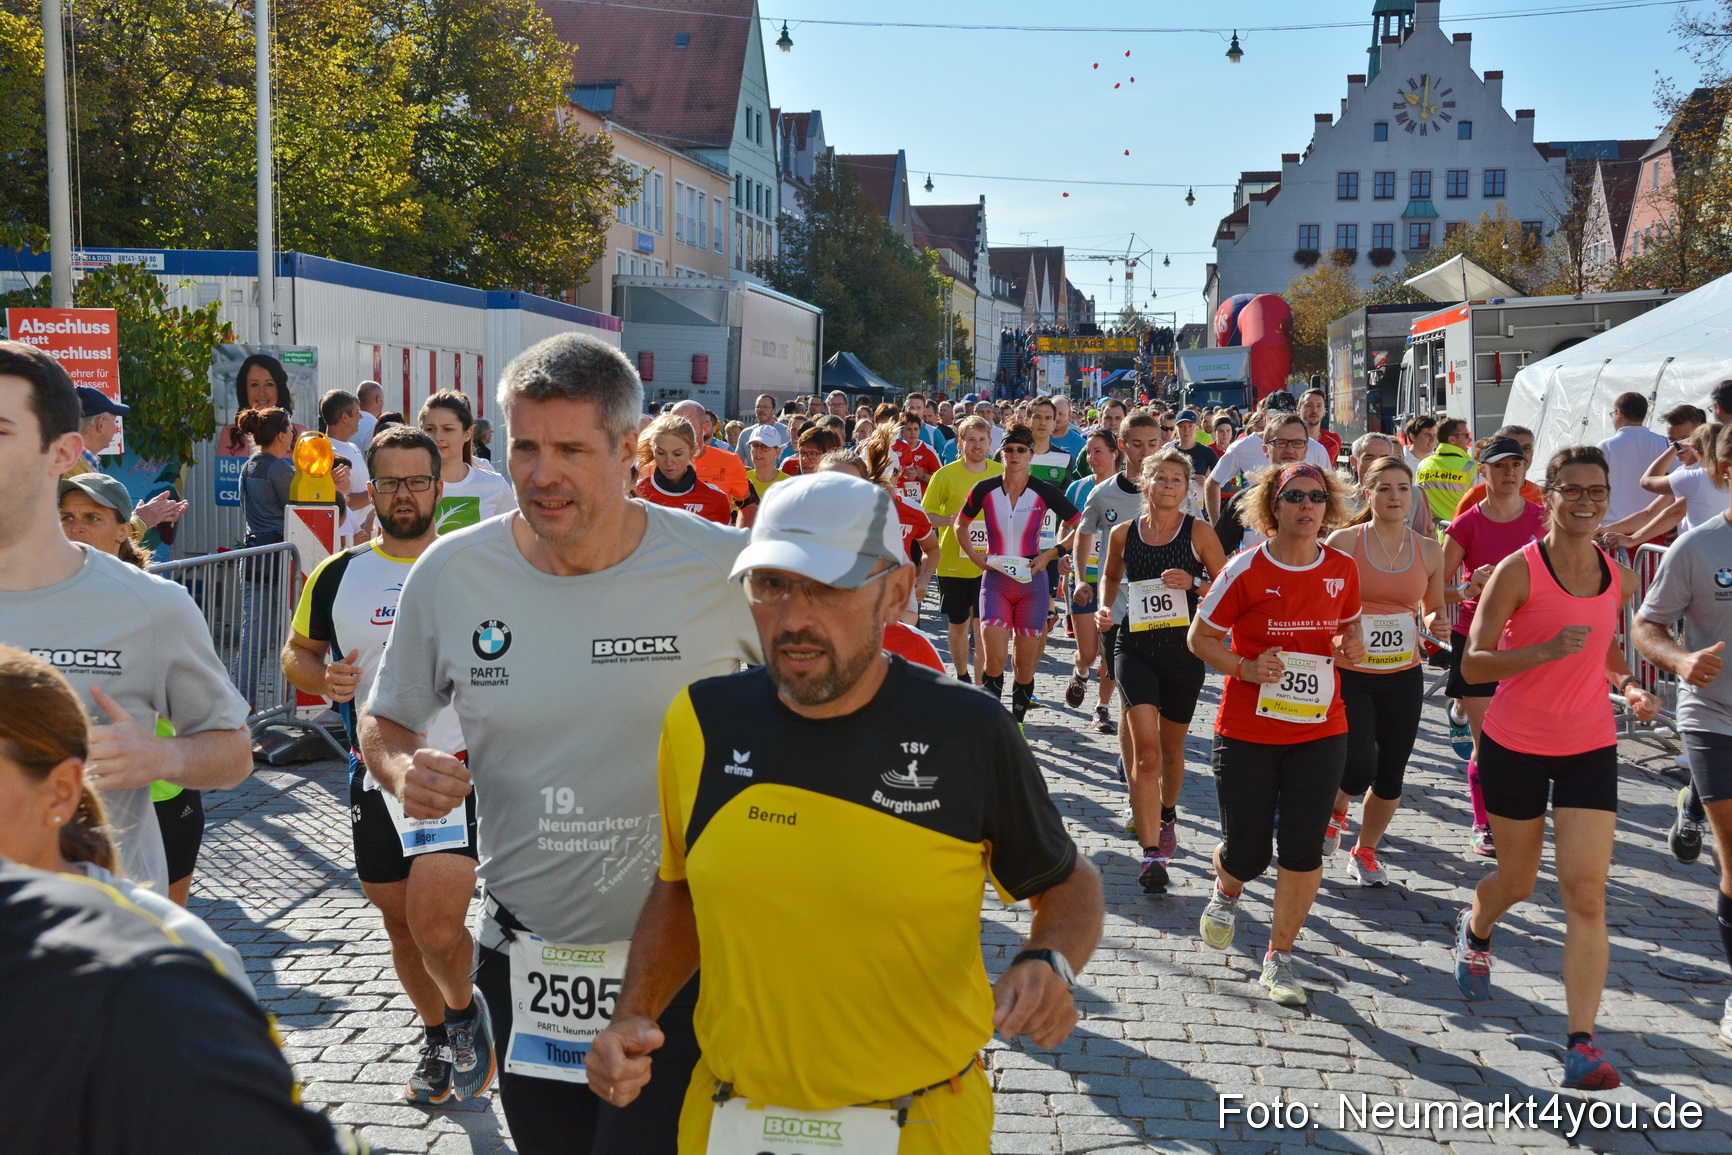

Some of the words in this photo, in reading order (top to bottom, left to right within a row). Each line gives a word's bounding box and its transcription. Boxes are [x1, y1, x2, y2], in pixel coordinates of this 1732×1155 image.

[19, 318, 110, 334] Abschluss
[20, 335, 49, 344] statt
[1070, 340, 1104, 349] START
[97, 369, 109, 377] für
[1141, 594, 1173, 614] 196
[476, 620, 510, 634] BMW
[592, 636, 681, 658] BOCK
[1370, 630, 1403, 647] 203
[30, 648, 122, 669] BOCK
[1288, 657, 1317, 668] BOCK
[1368, 656, 1403, 664] Franziska
[470, 667, 510, 678] PARTL
[470, 678, 509, 687] Neumarkt
[1280, 670, 1319, 695] 359
[900, 742, 930, 755] TSV
[724, 764, 754, 778] erima
[540, 786, 584, 815] 19.
[871, 789, 941, 814] Burgthann
[538, 816, 642, 833] Neumarkter
[748, 806, 798, 826] Bernd
[537, 835, 621, 853] Stadtlauf
[608, 850, 643, 887] September
[541, 946, 606, 964] BOCK
[527, 971, 622, 1020] 2595
[537, 1021, 561, 1034] PARTL
[545, 1042, 587, 1066] Thom
[763, 1116, 843, 1140] BOCK
